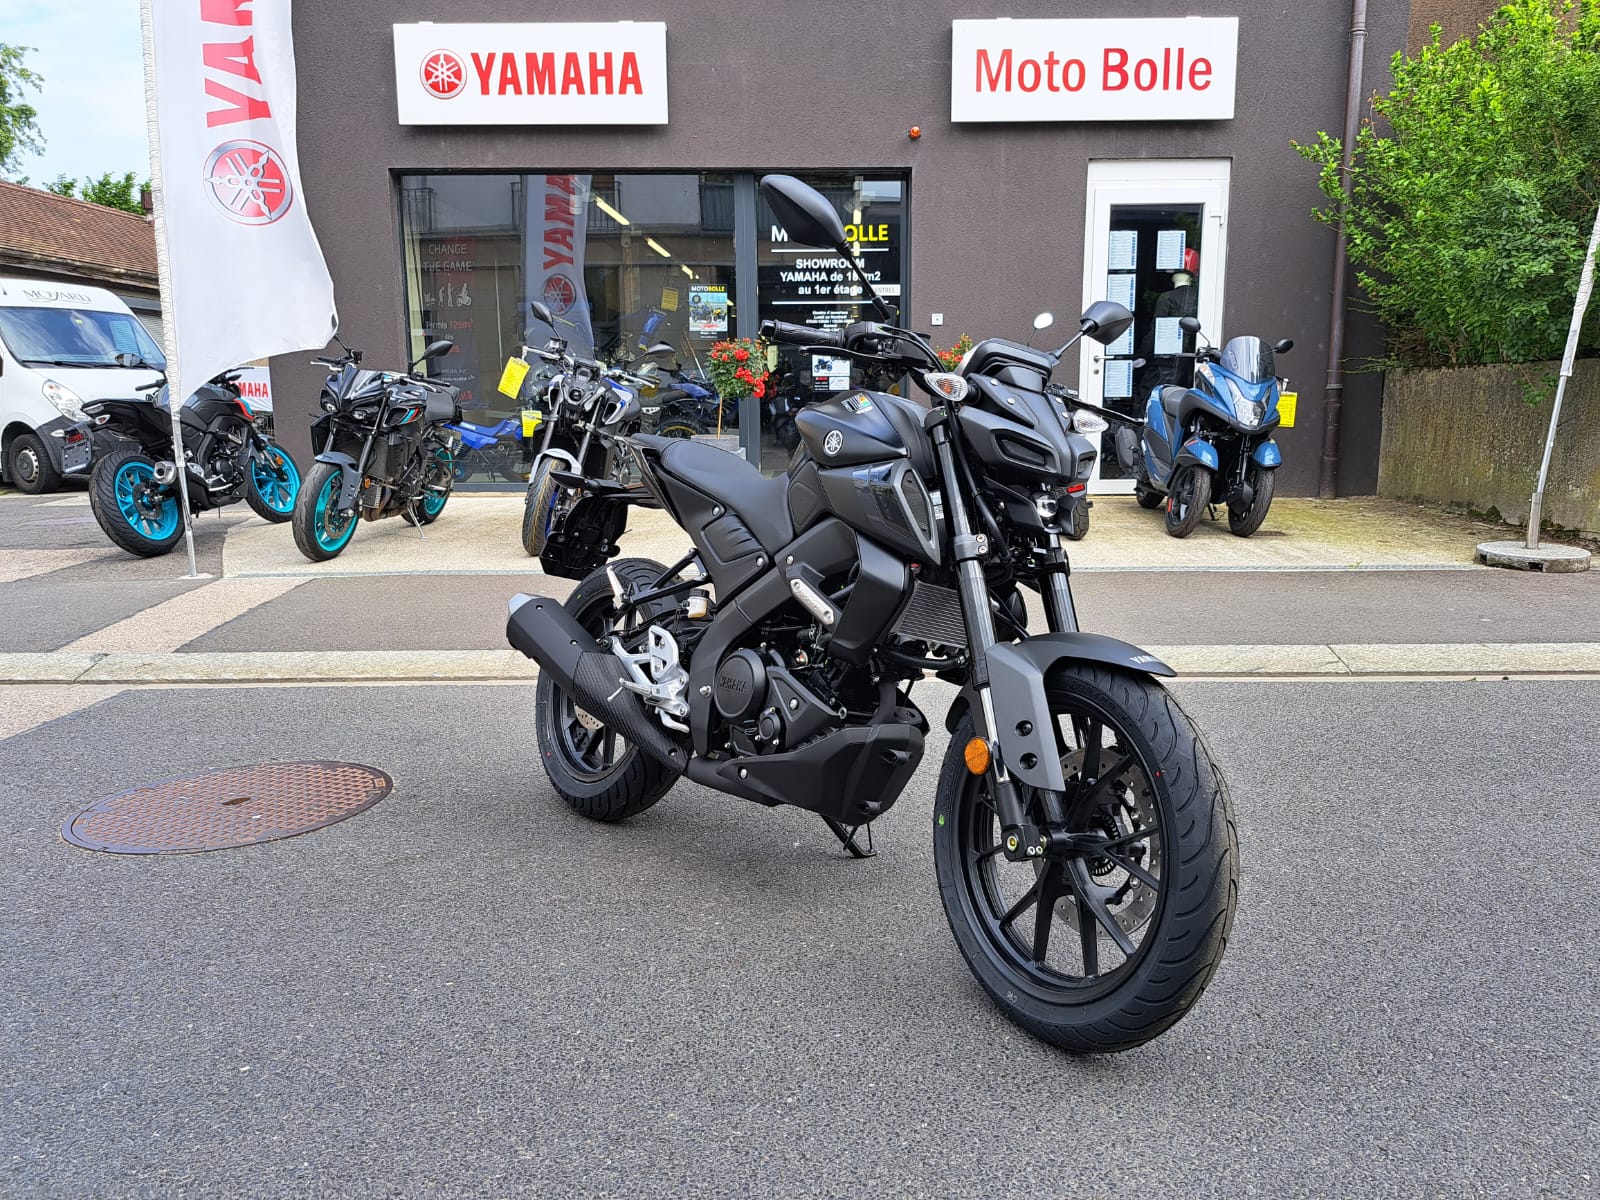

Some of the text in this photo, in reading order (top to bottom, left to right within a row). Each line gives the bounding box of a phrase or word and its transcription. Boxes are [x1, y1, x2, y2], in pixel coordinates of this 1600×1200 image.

[470, 52, 643, 95] YAMAHA
[976, 47, 1213, 92] Moto Bolle
[771, 224, 889, 243] MOLLE
[428, 243, 468, 255] CHANGE
[423, 261, 473, 272] THE GAME
[780, 271, 828, 282] YAMAHA
[830, 271, 843, 281] de
[798, 284, 863, 296] au 1er étage
[237, 381, 269, 398] MAHA
